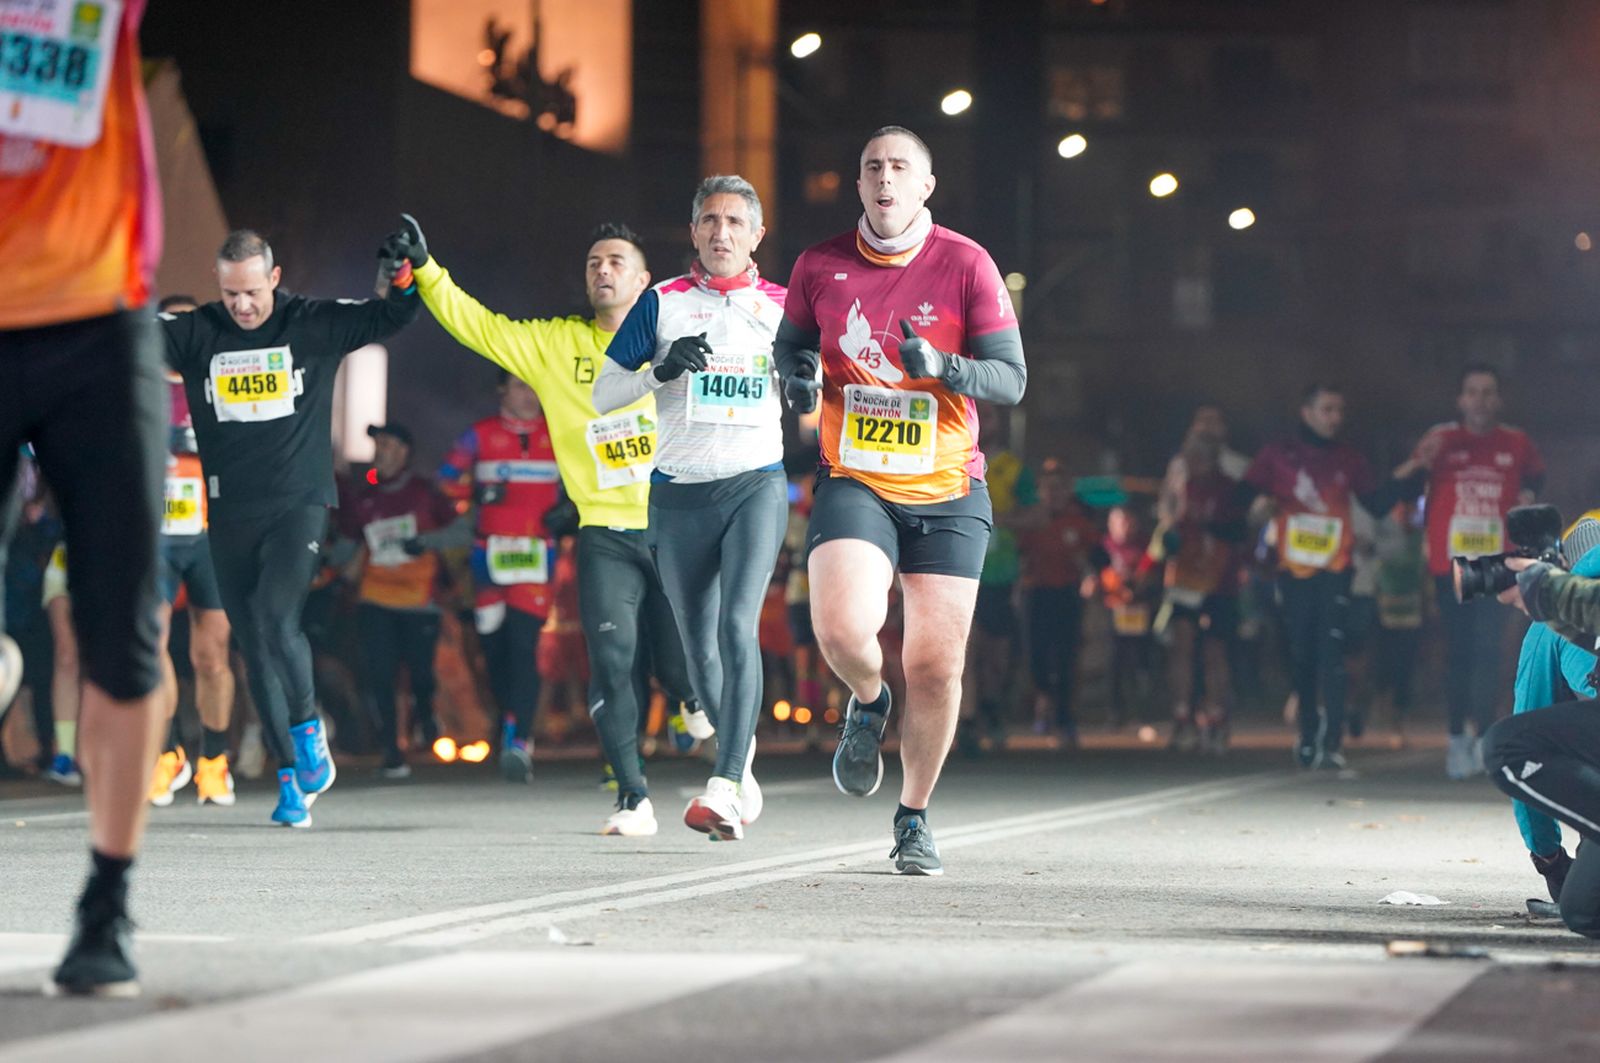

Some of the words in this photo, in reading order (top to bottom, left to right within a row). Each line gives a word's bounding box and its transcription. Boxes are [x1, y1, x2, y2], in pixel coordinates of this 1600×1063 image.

[0, 33, 88, 90] 338
[710, 355, 734, 364] NOCHE
[857, 345, 882, 369] 43
[228, 373, 277, 396] 4458
[699, 374, 763, 399] 14045
[852, 404, 870, 415] SAN
[863, 396, 890, 407] NOCHE
[891, 399, 902, 409] DE
[855, 416, 922, 446] 12210
[605, 435, 652, 462] 4458
